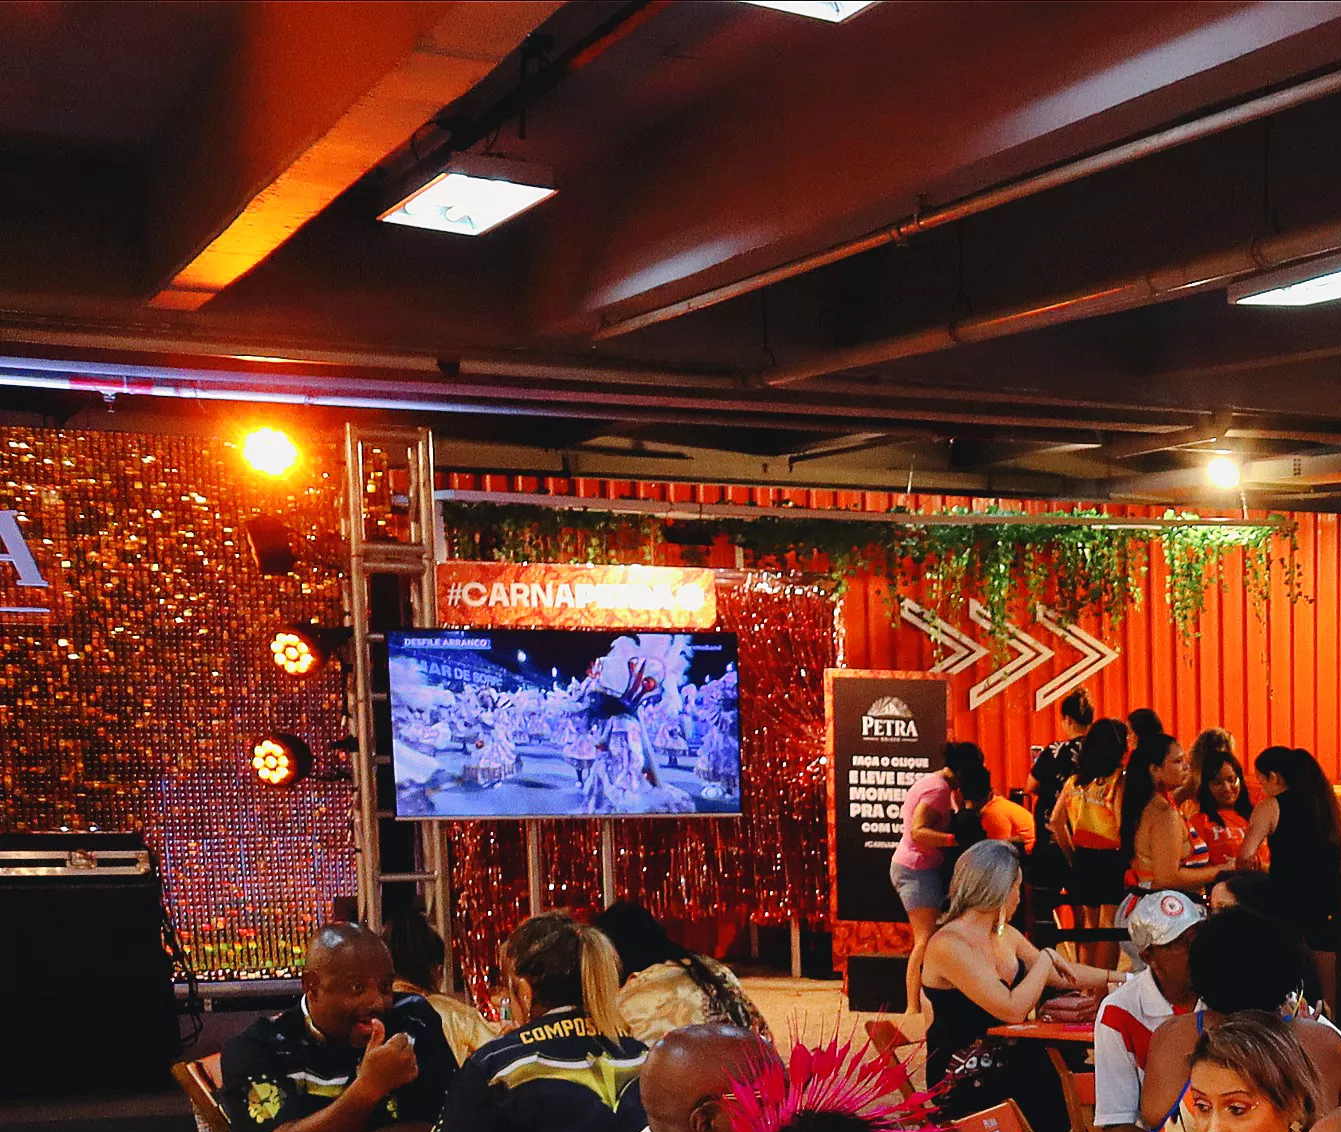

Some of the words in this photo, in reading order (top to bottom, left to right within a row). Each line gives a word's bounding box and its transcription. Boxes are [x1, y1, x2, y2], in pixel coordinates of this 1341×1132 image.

[861, 715, 919, 738] PETRA
[852, 755, 880, 768] FAÇA
[881, 757, 890, 766] O
[891, 757, 929, 769] CLIQUE
[848, 770, 858, 784] E
[860, 771, 895, 785] LEVE
[897, 772, 929, 785] ESS
[849, 803, 885, 818] PRA
[861, 822, 891, 833] COM
